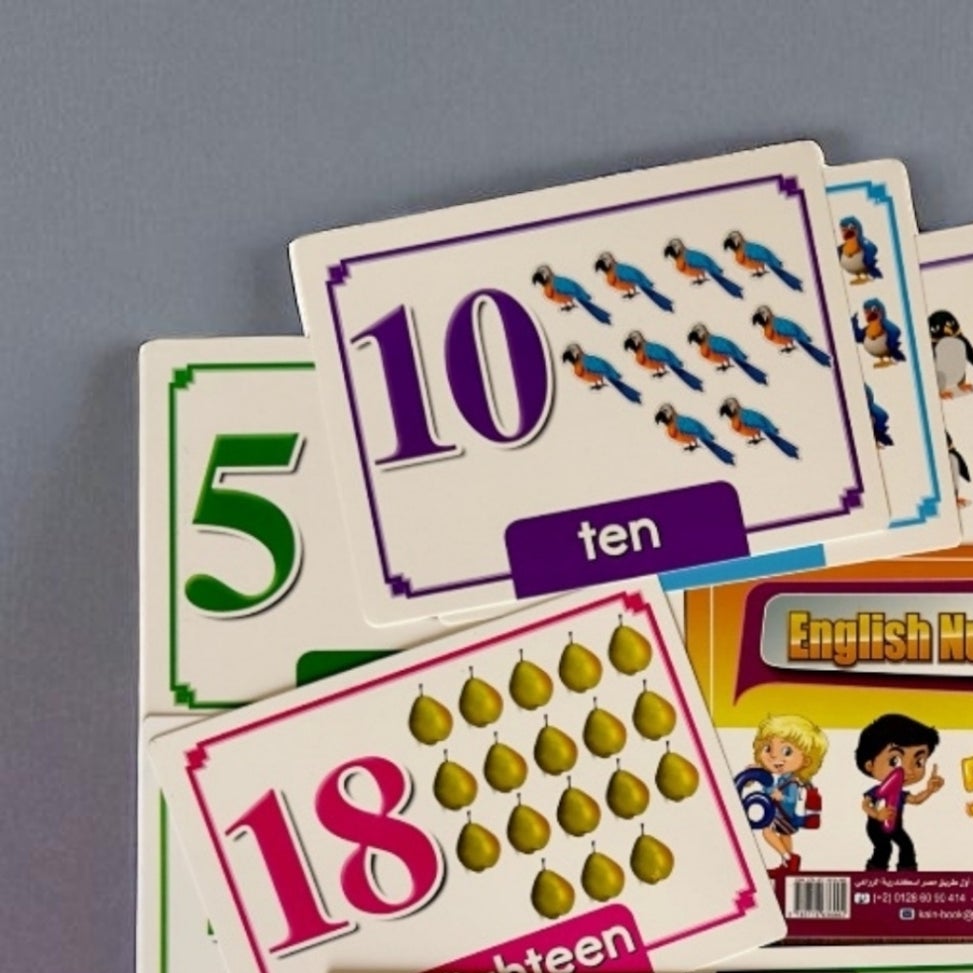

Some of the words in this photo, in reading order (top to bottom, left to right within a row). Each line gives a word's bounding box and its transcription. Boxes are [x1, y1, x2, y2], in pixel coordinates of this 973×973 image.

[350, 288, 554, 471] 10
[185, 433, 305, 618] 5
[577, 515, 662, 561] ten
[788, 610, 934, 668] English
[225, 755, 446, 958] 18
